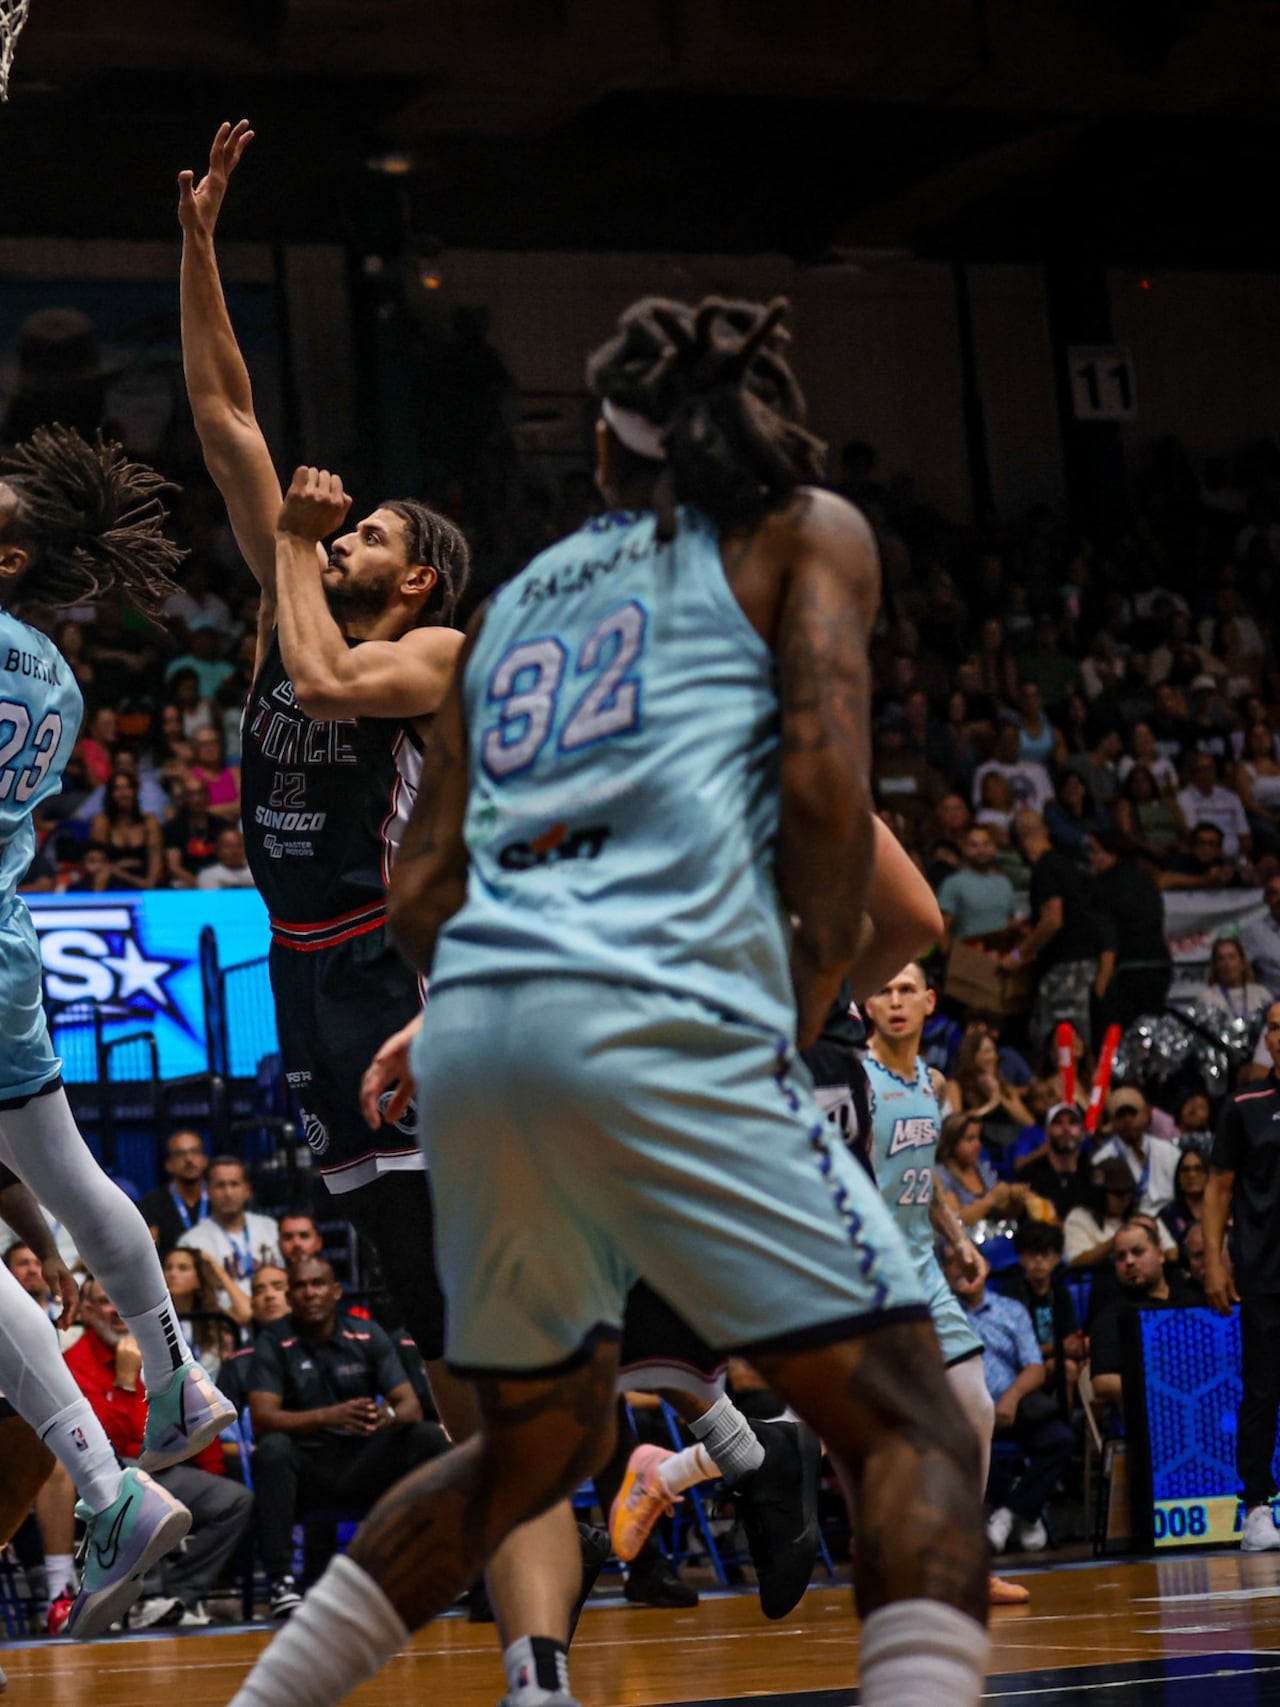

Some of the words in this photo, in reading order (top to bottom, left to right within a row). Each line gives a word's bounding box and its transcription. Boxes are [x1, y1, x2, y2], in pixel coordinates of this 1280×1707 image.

[1076, 361, 1131, 411] 11
[481, 600, 647, 784] 32
[254, 804, 328, 832] SUNOCO
[898, 1167, 932, 1205] 22
[1154, 1505, 1207, 1538] 008
